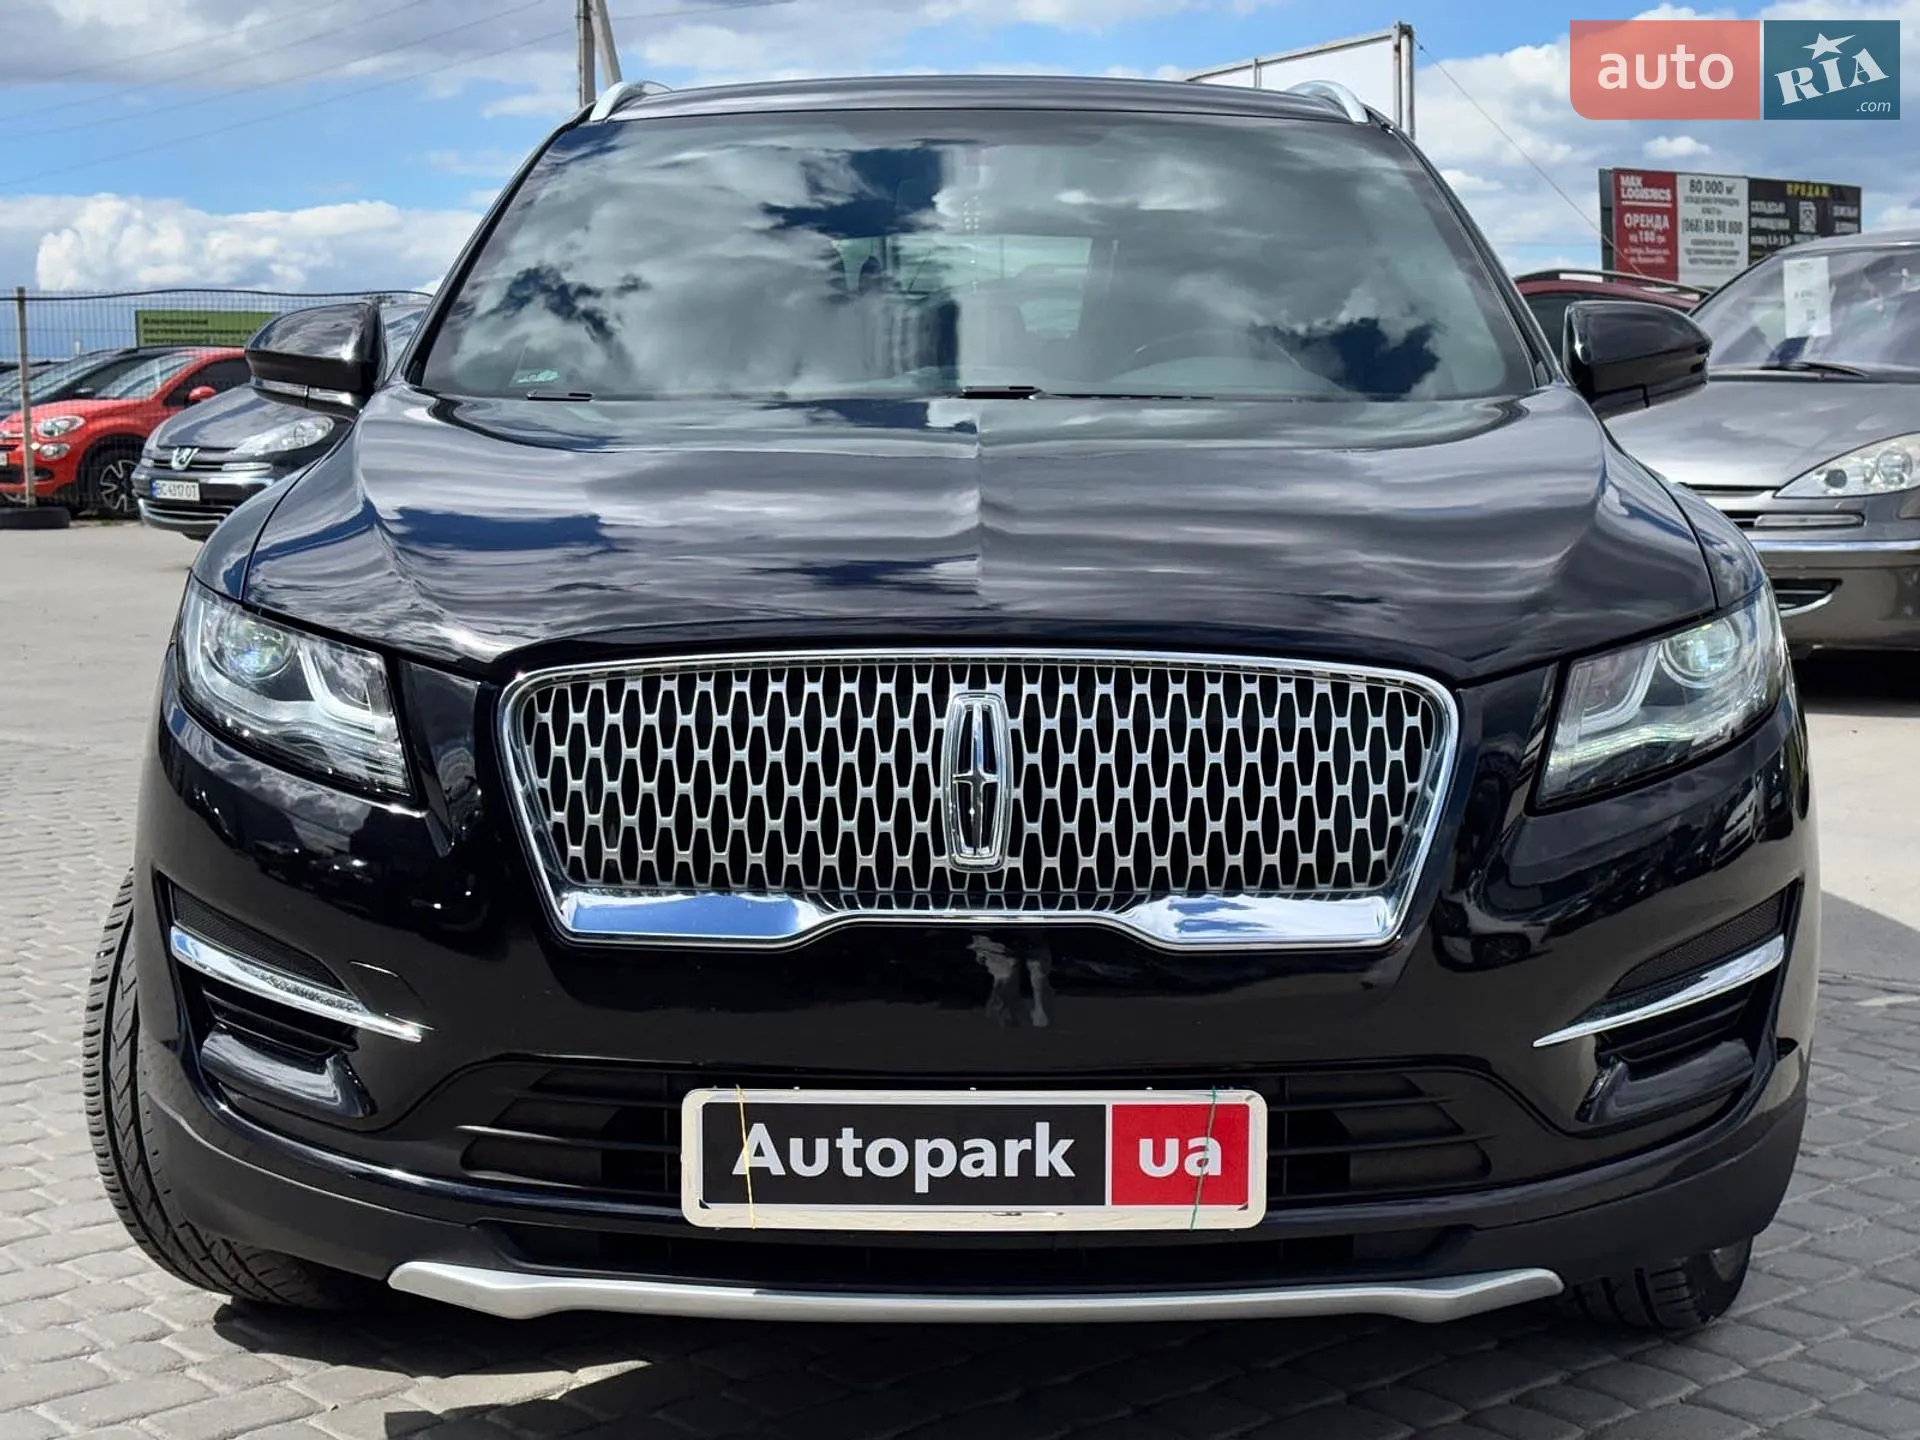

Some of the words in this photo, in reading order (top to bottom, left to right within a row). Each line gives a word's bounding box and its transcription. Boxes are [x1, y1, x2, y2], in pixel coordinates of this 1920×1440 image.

[1623, 213, 1670, 230] ОРЕНДА
[732, 1122, 1076, 1193] Autopark
[1138, 1136, 1222, 1178] ua
